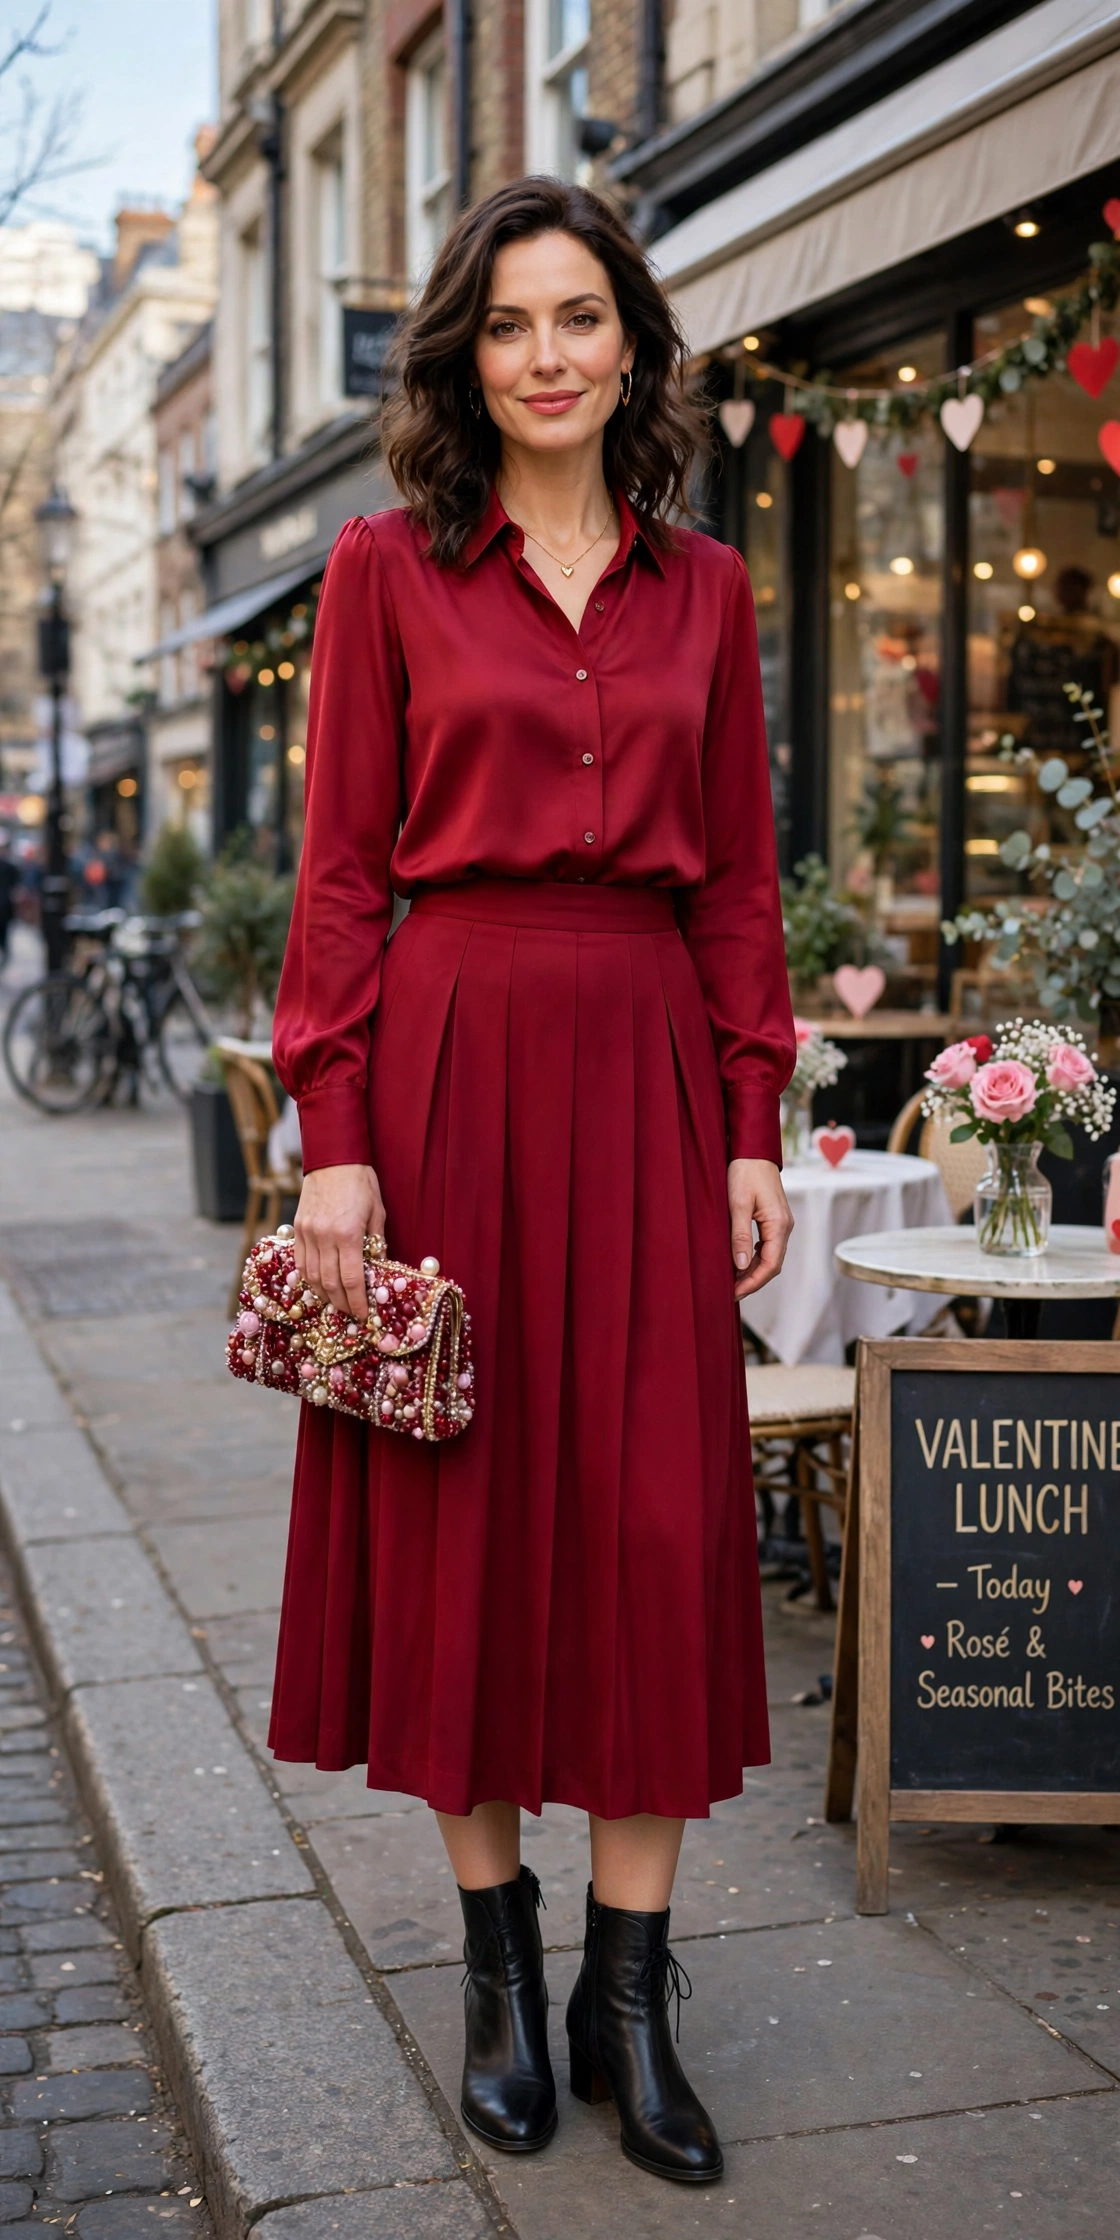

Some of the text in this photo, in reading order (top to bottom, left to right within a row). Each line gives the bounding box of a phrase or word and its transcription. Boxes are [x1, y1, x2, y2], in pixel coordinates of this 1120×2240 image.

[914, 1418, 1120, 1471] VALENTINE
[955, 1483, 1088, 1534] LUNCH
[967, 1563, 1051, 1614] Today
[946, 1619, 1047, 1659] Rosé &
[917, 1670, 1115, 1710] Seasonal Bites
